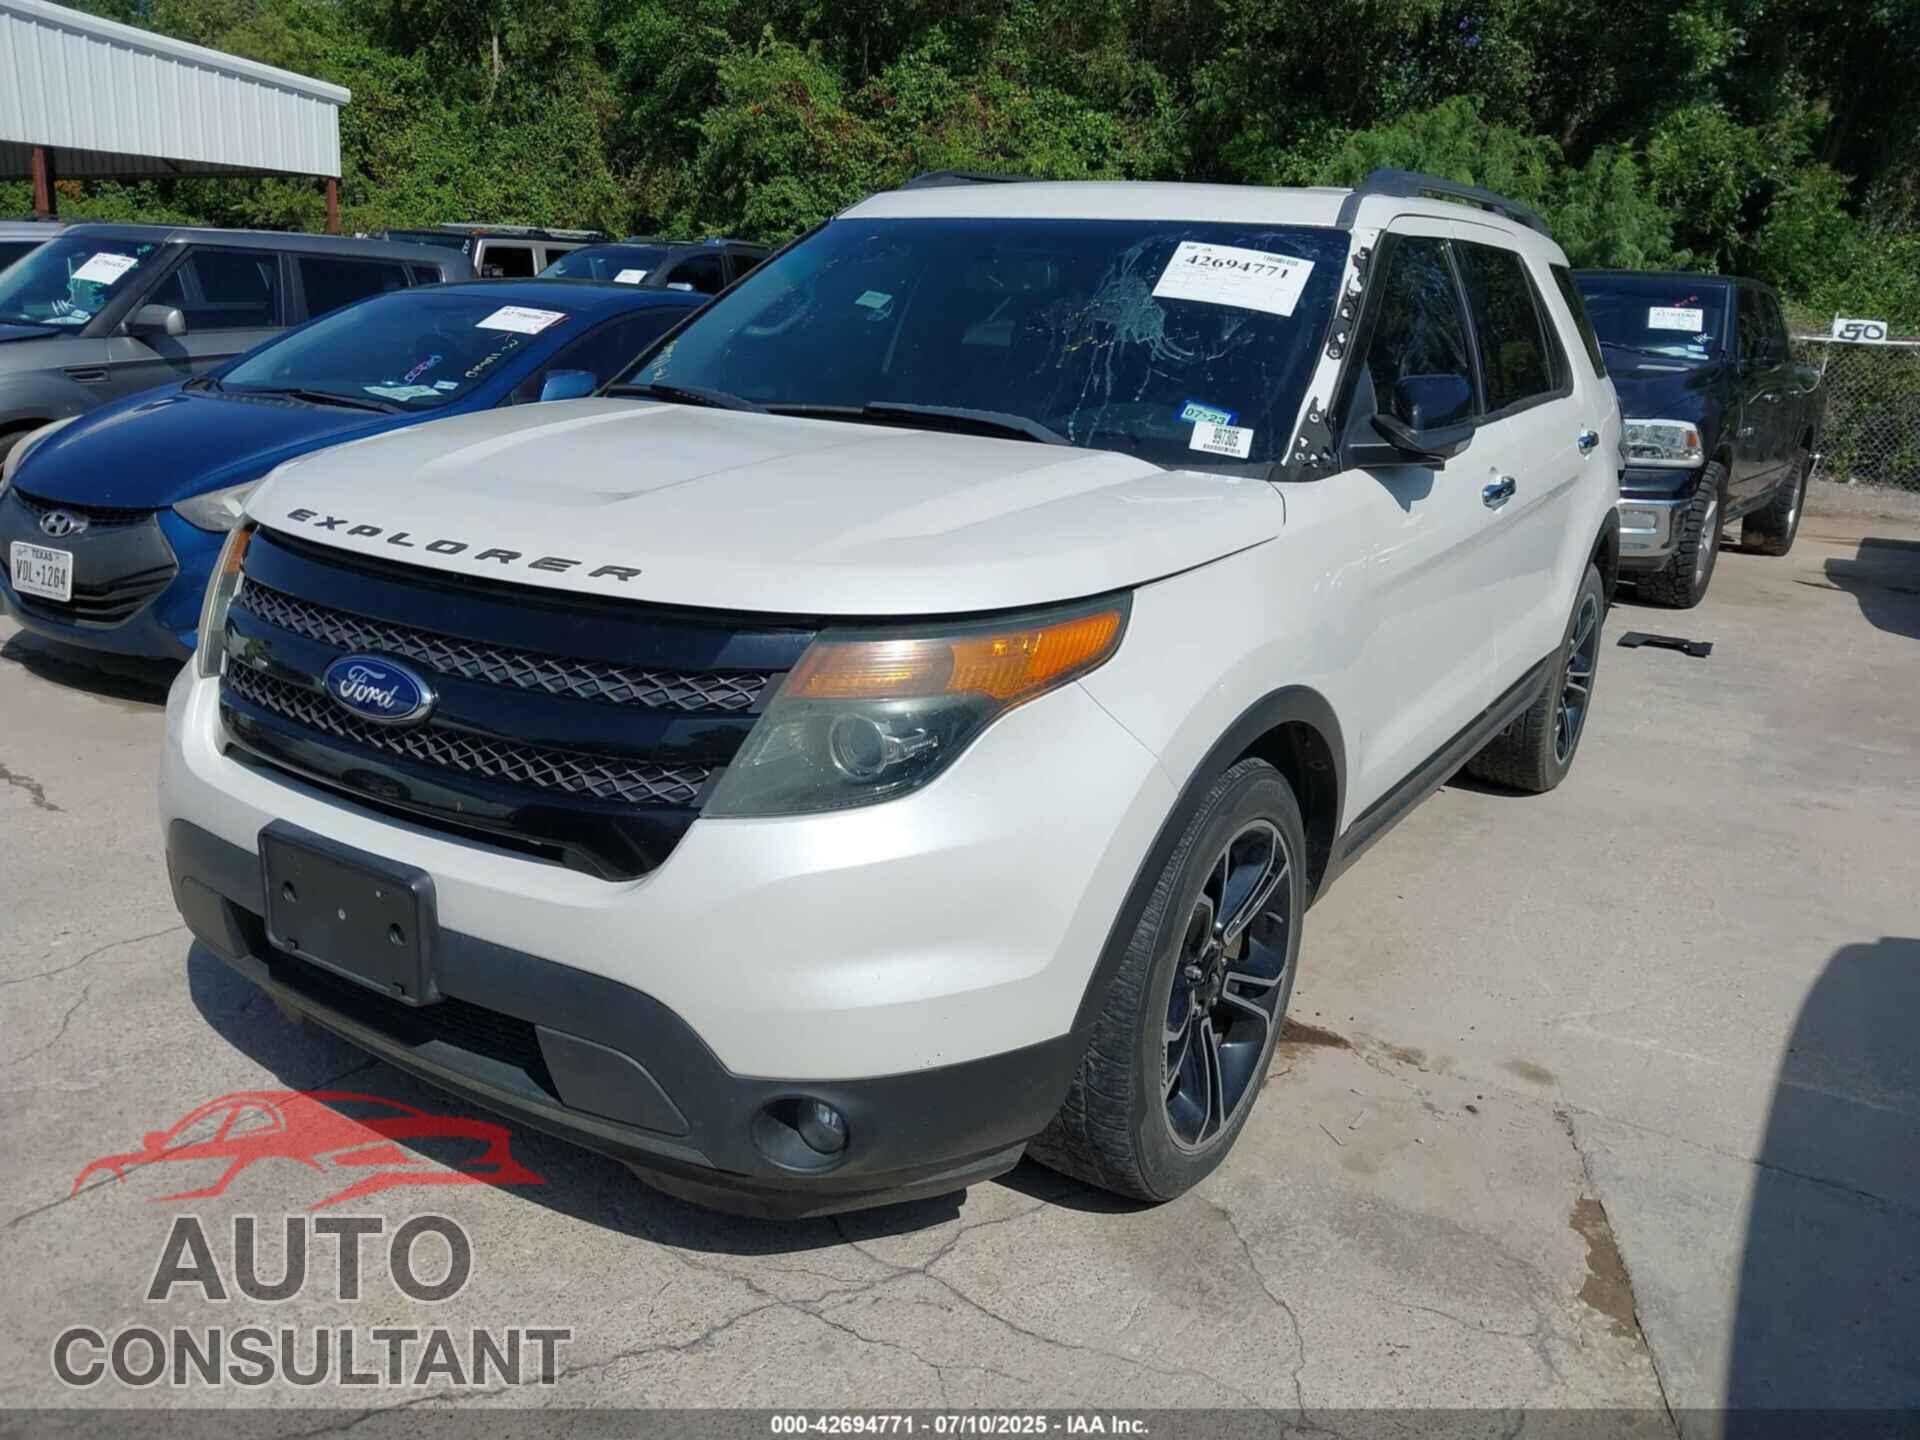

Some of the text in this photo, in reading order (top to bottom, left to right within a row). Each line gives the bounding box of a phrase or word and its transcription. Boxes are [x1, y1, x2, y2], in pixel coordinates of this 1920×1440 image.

[1184, 254, 1290, 279] 42694771
[1838, 323, 1884, 341] 50
[1185, 407, 1226, 425] 07-23
[32, 548, 53, 562] TEXAS
[287, 508, 642, 582] EXPLORER
[339, 665, 399, 709] Ford
